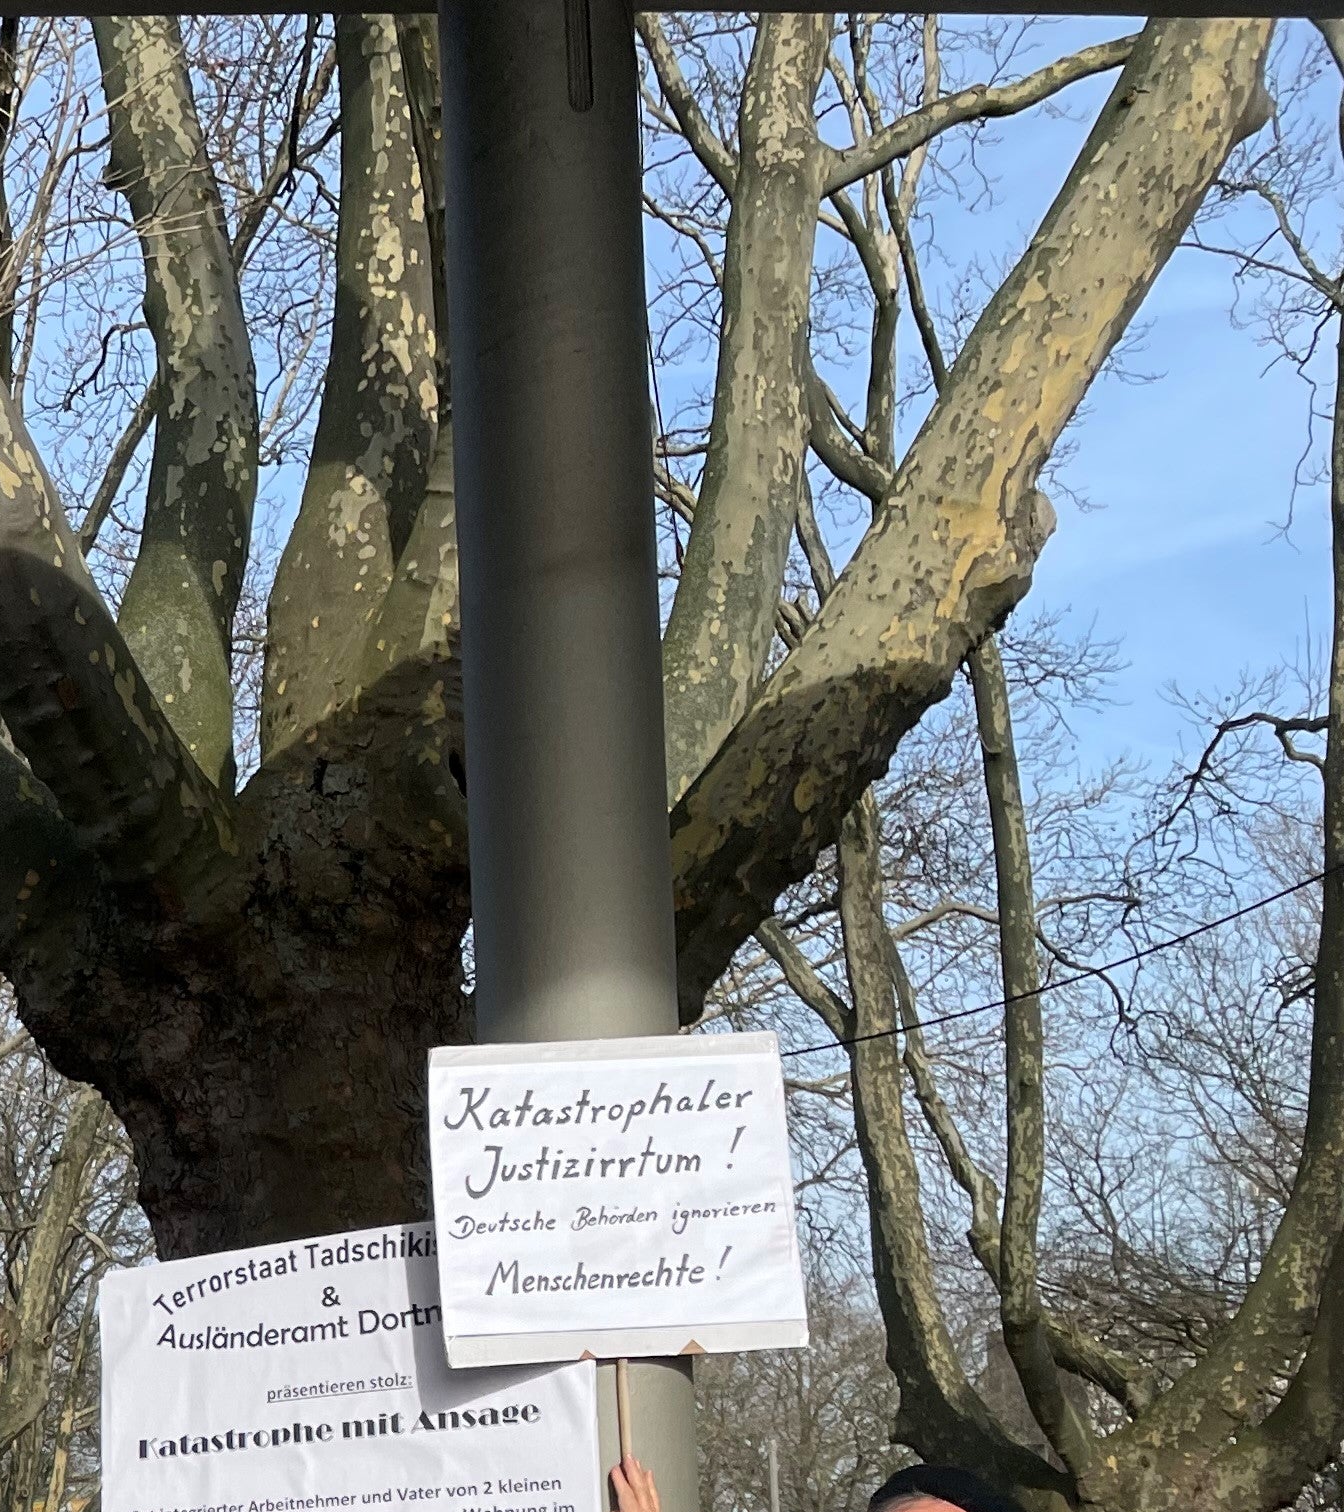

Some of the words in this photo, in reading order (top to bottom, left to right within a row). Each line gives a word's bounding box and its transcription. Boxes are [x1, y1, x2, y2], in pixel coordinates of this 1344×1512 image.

[444, 1079, 753, 1134] Katastrophaler
[448, 1213, 557, 1239] Deutsche
[570, 1205, 658, 1231] Behörden
[671, 1201, 777, 1235] ignorieren
[152, 1250, 298, 1316] Terrorstaat
[321, 1286, 341, 1307] &
[156, 1315, 349, 1350] Ausländeramt
[267, 1378, 365, 1403] präsentieren
[369, 1373, 413, 1389] stolz:
[138, 1421, 333, 1460] Katastrophe
[341, 1411, 405, 1439] mit
[411, 1402, 542, 1434] Ansage
[362, 1489, 393, 1503] und
[397, 1486, 442, 1501] Vater
[446, 1483, 478, 1497] von
[483, 1481, 493, 1495] 2
[498, 1478, 562, 1494] kleinen
